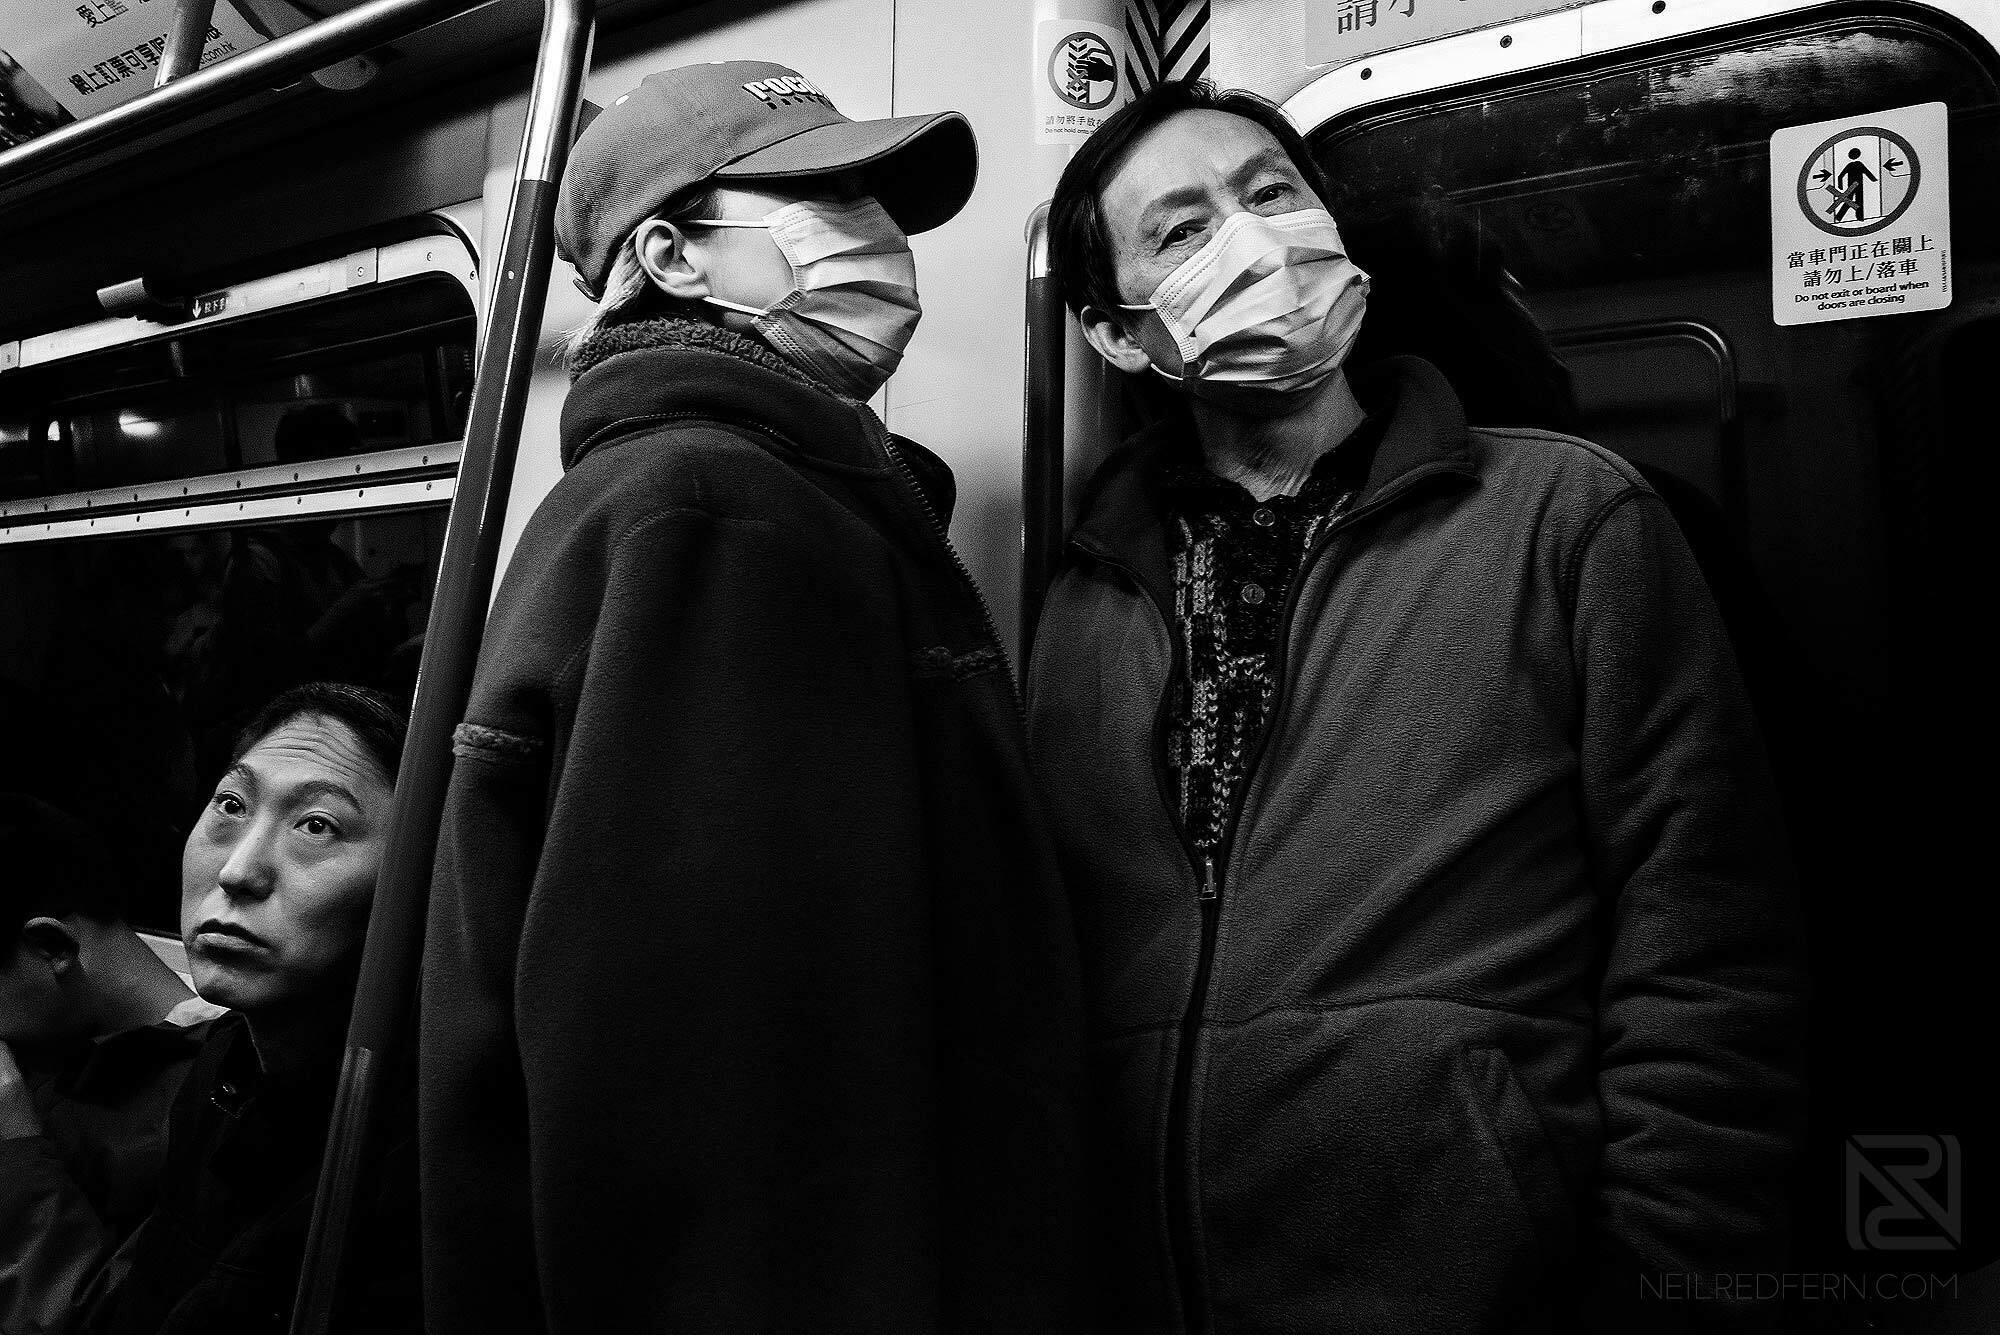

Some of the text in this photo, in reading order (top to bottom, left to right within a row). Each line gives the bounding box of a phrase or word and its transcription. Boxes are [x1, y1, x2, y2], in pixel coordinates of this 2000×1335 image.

[1787, 234, 1935, 268] 當車門正在關上
[1803, 258, 1919, 288] 請勿上/落車
[1795, 280, 1930, 303] Do not exit or board when
[1817, 294, 1906, 311] doors are closing
